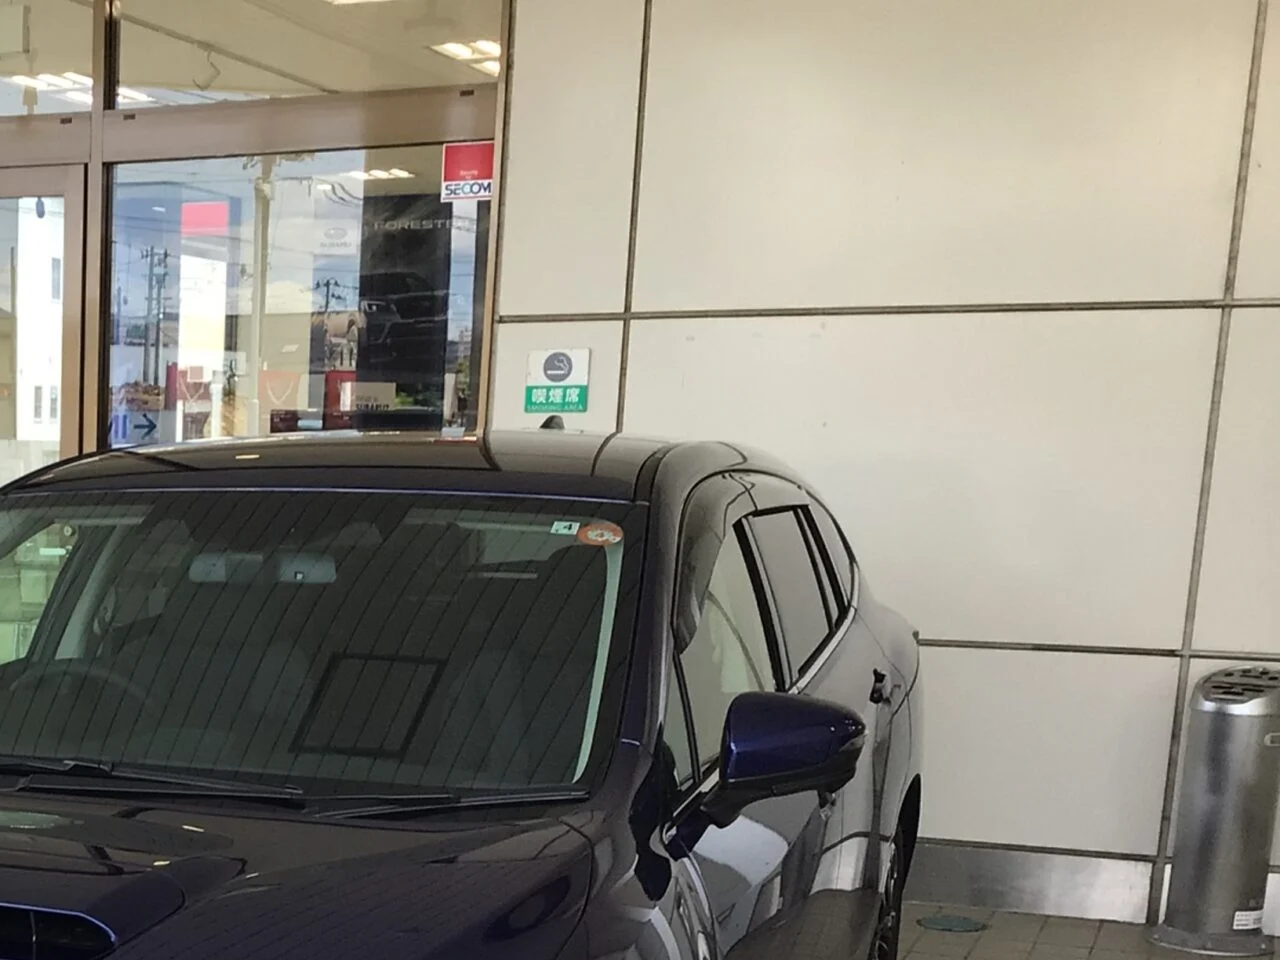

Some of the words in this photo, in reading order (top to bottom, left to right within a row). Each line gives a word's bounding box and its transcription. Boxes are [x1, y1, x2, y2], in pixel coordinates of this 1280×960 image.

[444, 181, 492, 197] SECOM
[531, 387, 581, 404] 喫煙席
